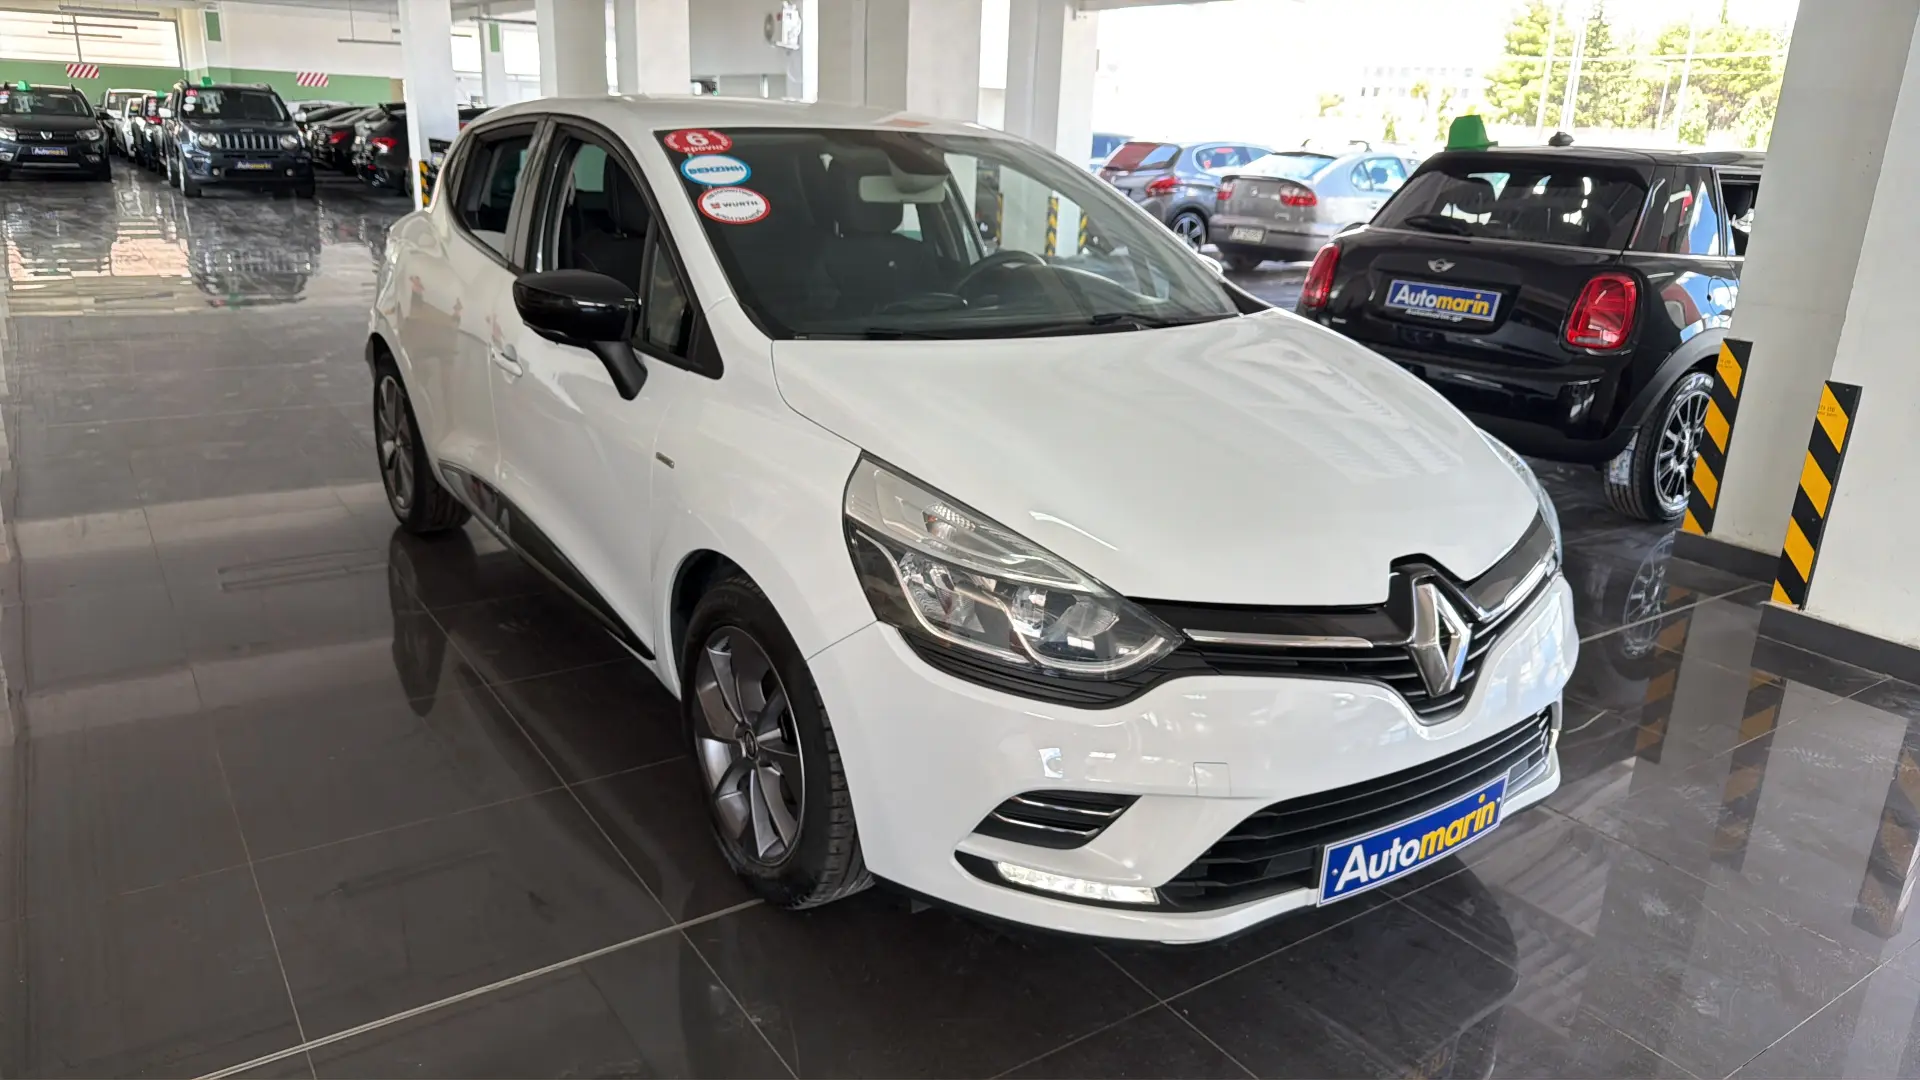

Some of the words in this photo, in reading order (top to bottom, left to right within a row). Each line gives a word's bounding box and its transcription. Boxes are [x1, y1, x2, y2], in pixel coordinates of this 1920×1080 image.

[685, 132, 709, 146] 6
[1393, 284, 1490, 315] Automarin
[1334, 793, 1496, 893] Automarin
